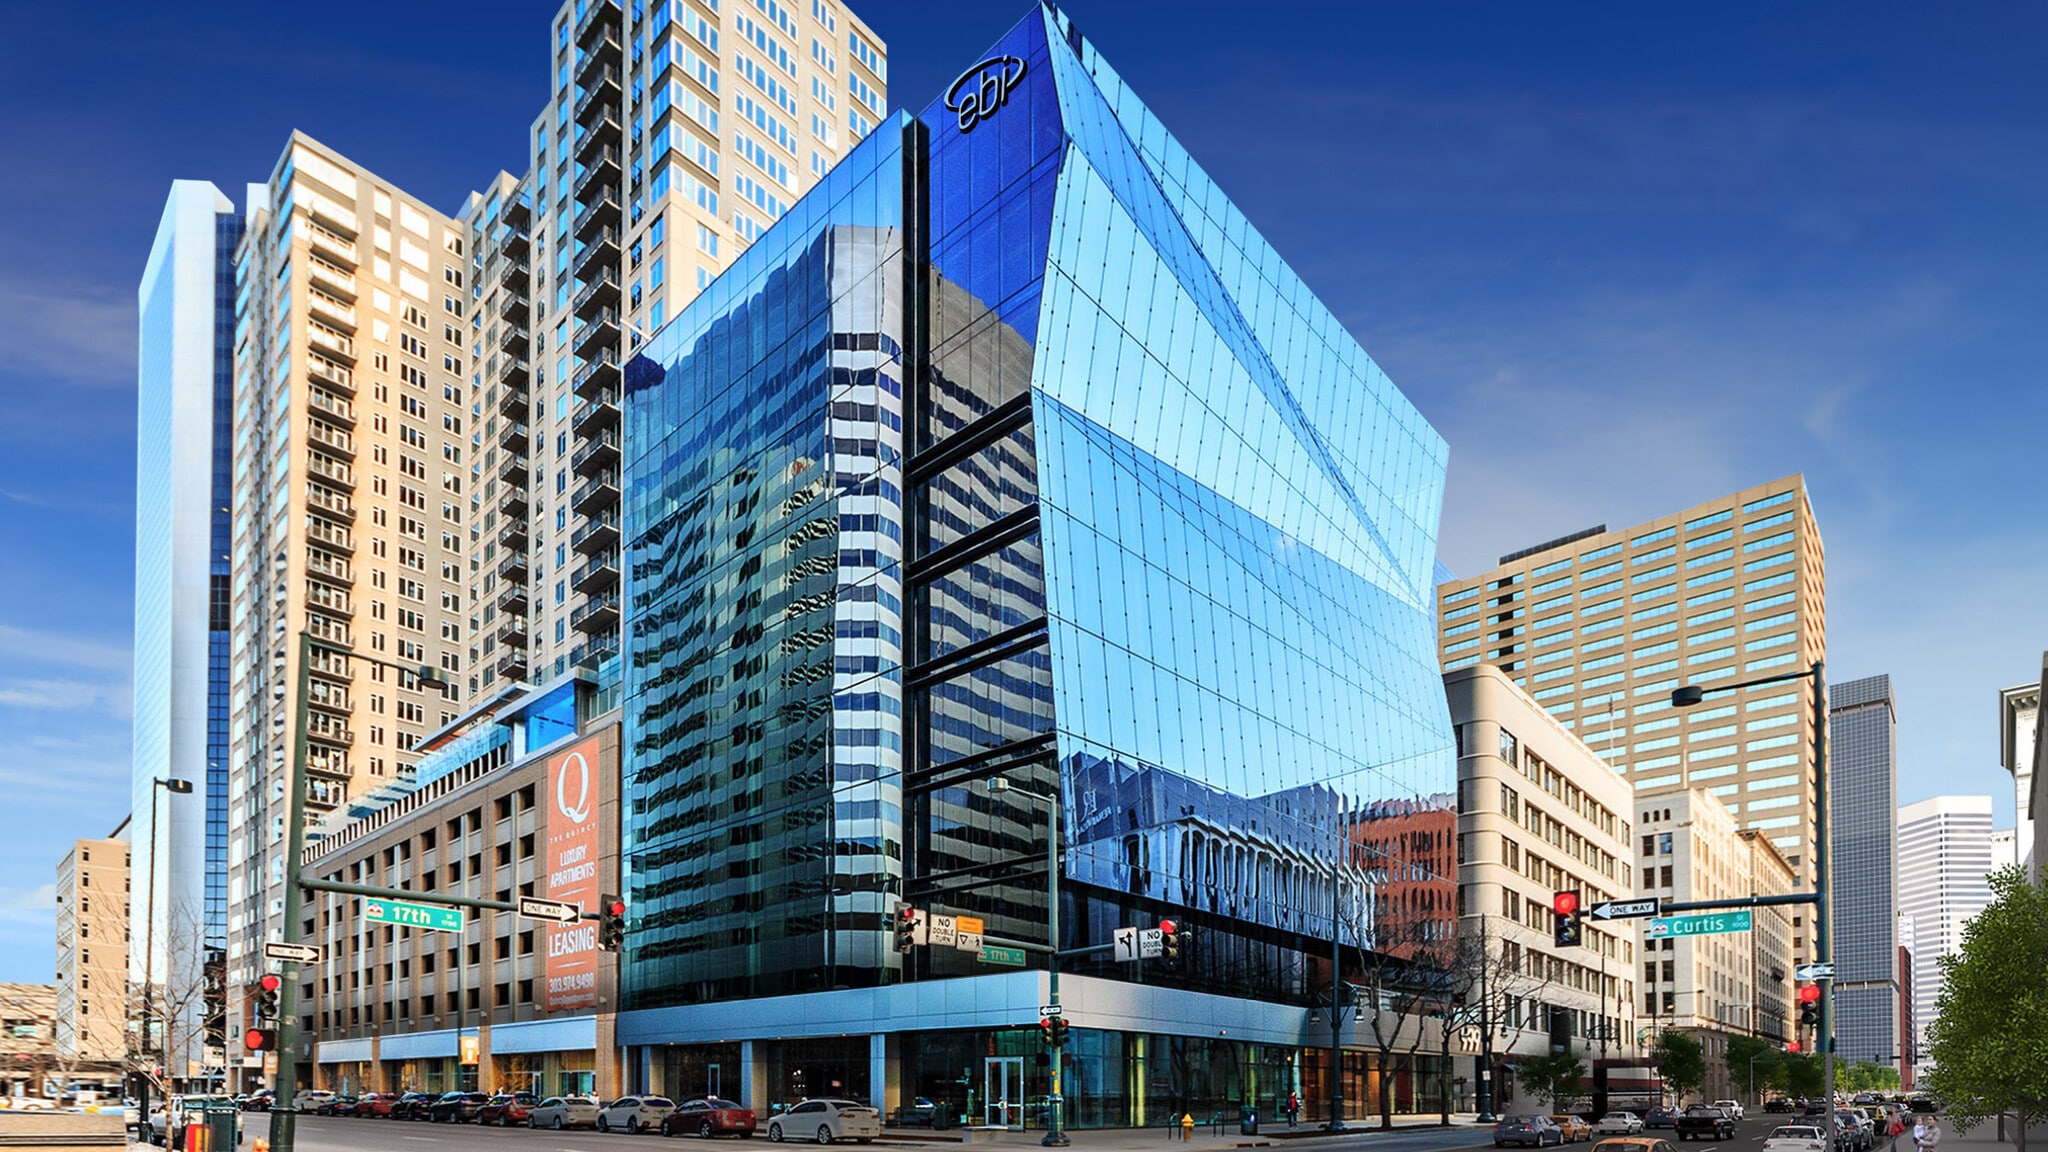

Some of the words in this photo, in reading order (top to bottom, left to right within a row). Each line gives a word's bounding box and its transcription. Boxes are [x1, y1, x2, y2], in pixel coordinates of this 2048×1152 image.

[957, 54, 1010, 134] ebi
[557, 752, 591, 824] Q
[566, 822, 597, 840] QUINCY
[560, 843, 588, 867] LUXURY
[550, 860, 595, 889] APARTMENTS
[393, 906, 431, 925] 17th
[526, 903, 542, 913] ONE
[1609, 905, 1628, 915] ONE
[1631, 903, 1651, 913] WAY
[938, 918, 950, 927] NO
[1673, 916, 1724, 934] Curtis
[932, 927, 954, 937] DOUBLE
[935, 935, 950, 943] TURN
[1147, 930, 1160, 940] NO
[549, 926, 595, 958] LEASING
[1143, 941, 1162, 949] DOUBL
[991, 950, 1010, 961] 17th
